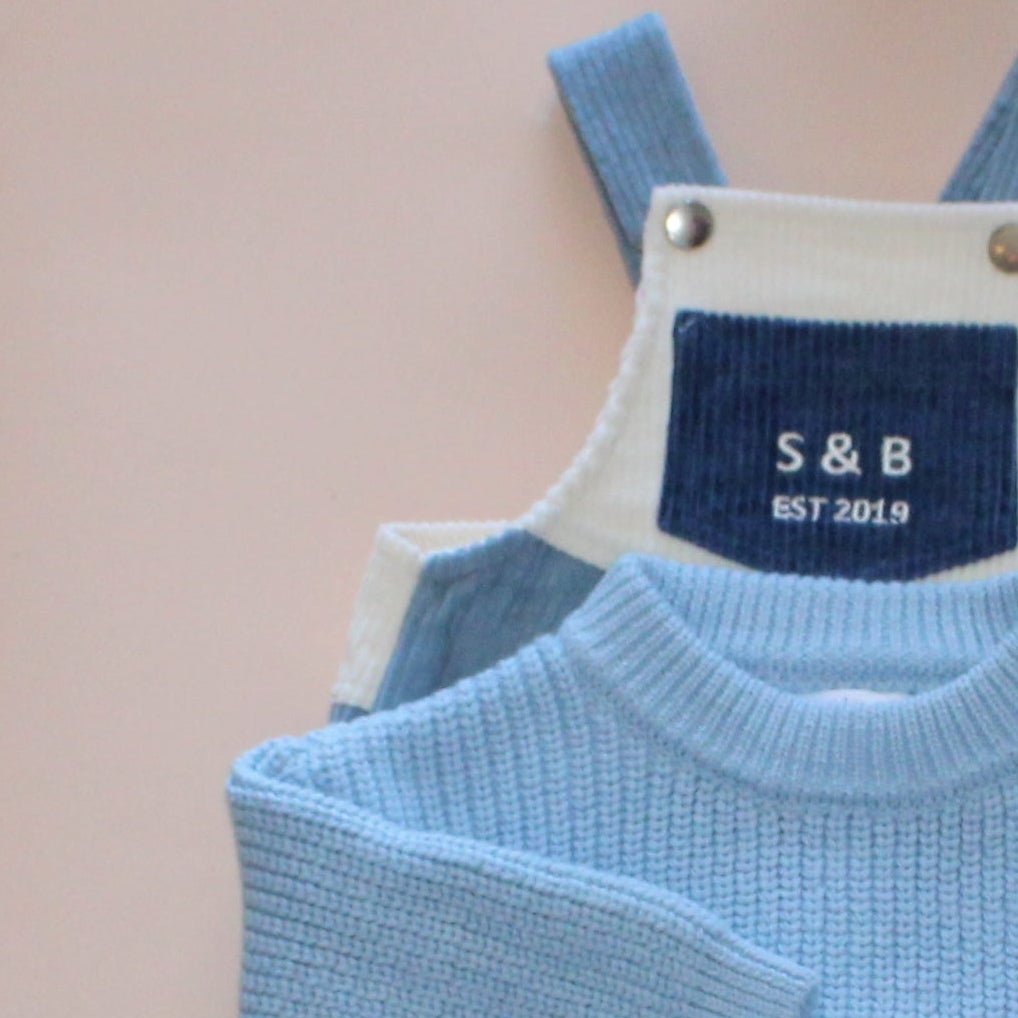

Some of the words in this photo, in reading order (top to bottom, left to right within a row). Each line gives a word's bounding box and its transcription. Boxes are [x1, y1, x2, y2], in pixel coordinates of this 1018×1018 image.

[776, 431, 805, 473] S
[821, 432, 862, 475] &
[881, 435, 912, 476] B
[771, 494, 829, 522] EST
[833, 497, 910, 525] 2019
